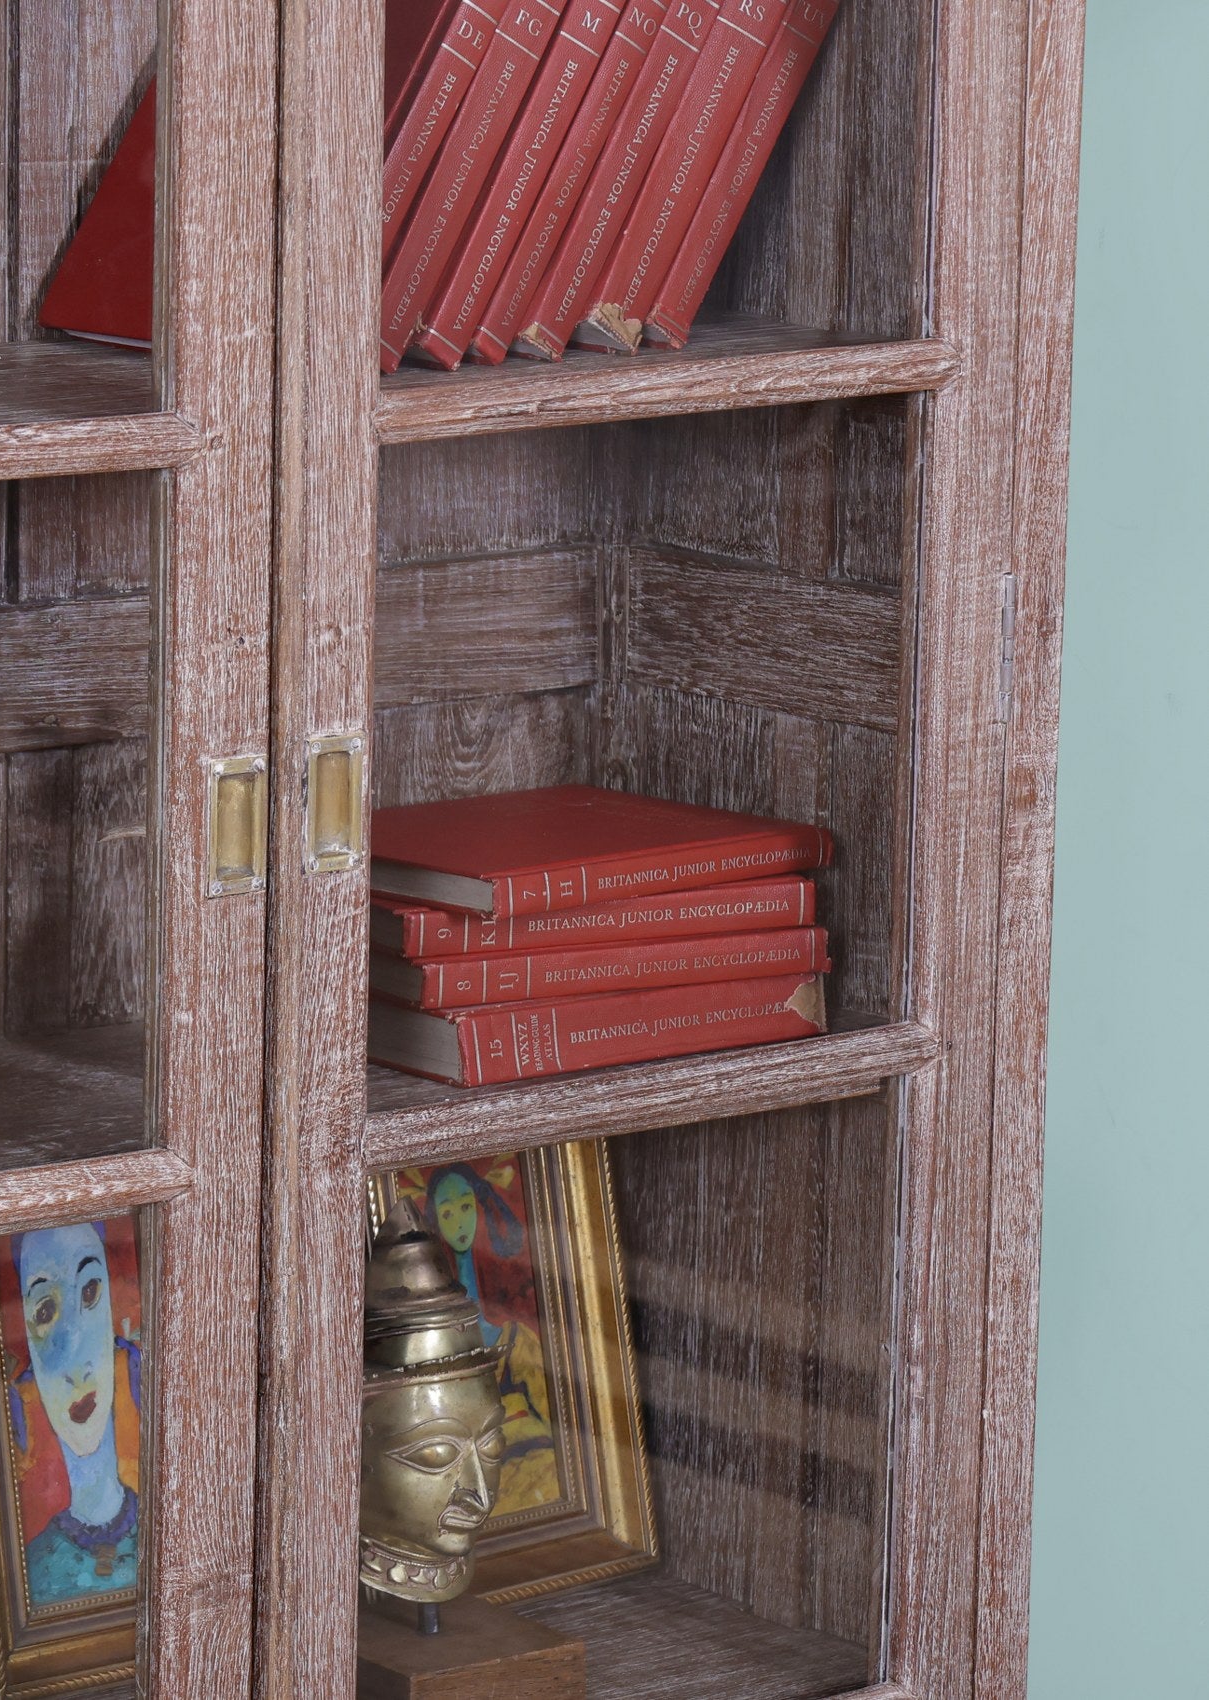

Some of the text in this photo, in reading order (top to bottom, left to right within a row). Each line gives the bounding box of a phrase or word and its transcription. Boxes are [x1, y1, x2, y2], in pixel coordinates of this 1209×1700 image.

[515, 8, 543, 38] FG
[581, 10, 603, 35] M
[628, 6, 657, 36] NO
[675, 2, 703, 39] PQ
[738, 0, 766, 22] RS
[456, 19, 486, 50] DE
[468, 60, 516, 151] BRITANNICA
[582, 58, 630, 148] BRITANNICA
[694, 45, 740, 135] BRITANNICA
[752, 48, 799, 137] BRITANNICA
[408, 71, 458, 164] BRITANNICA
[442, 151, 475, 211] JUNIOR
[554, 147, 588, 208] JUNIOR
[669, 133, 702, 194] JUNIOR
[728, 135, 759, 196] JUNIOR
[452, 58, 579, 331] BRITANNICA JUNIOR ENCYCLOPÆDIA
[555, 53, 679, 322] BRITANNICA JUNIOR ENCYCLOPÆDIA
[523, 889, 536, 899] 7
[559, 879, 573, 897] H
[597, 869, 669, 890] BRITANNICA
[672, 861, 717, 881] JUNIOR
[528, 899, 790, 932] BRITANNICA JUNIOR ENCYCLOPÆDIA
[499, 971, 519, 991] IJ
[544, 948, 801, 983] BRITANNICA JUNIOR ENCYCLOPÆDIA
[456, 980, 471, 991] 8
[517, 1022, 531, 1066] WXYZ
[529, 1013, 544, 1072] READING GUIDE
[542, 1022, 553, 1060] ATLAS
[569, 1022, 649, 1044] BRITANNICA
[651, 1015, 701, 1036] JUNIOR
[489, 1038, 504, 1059] 15
